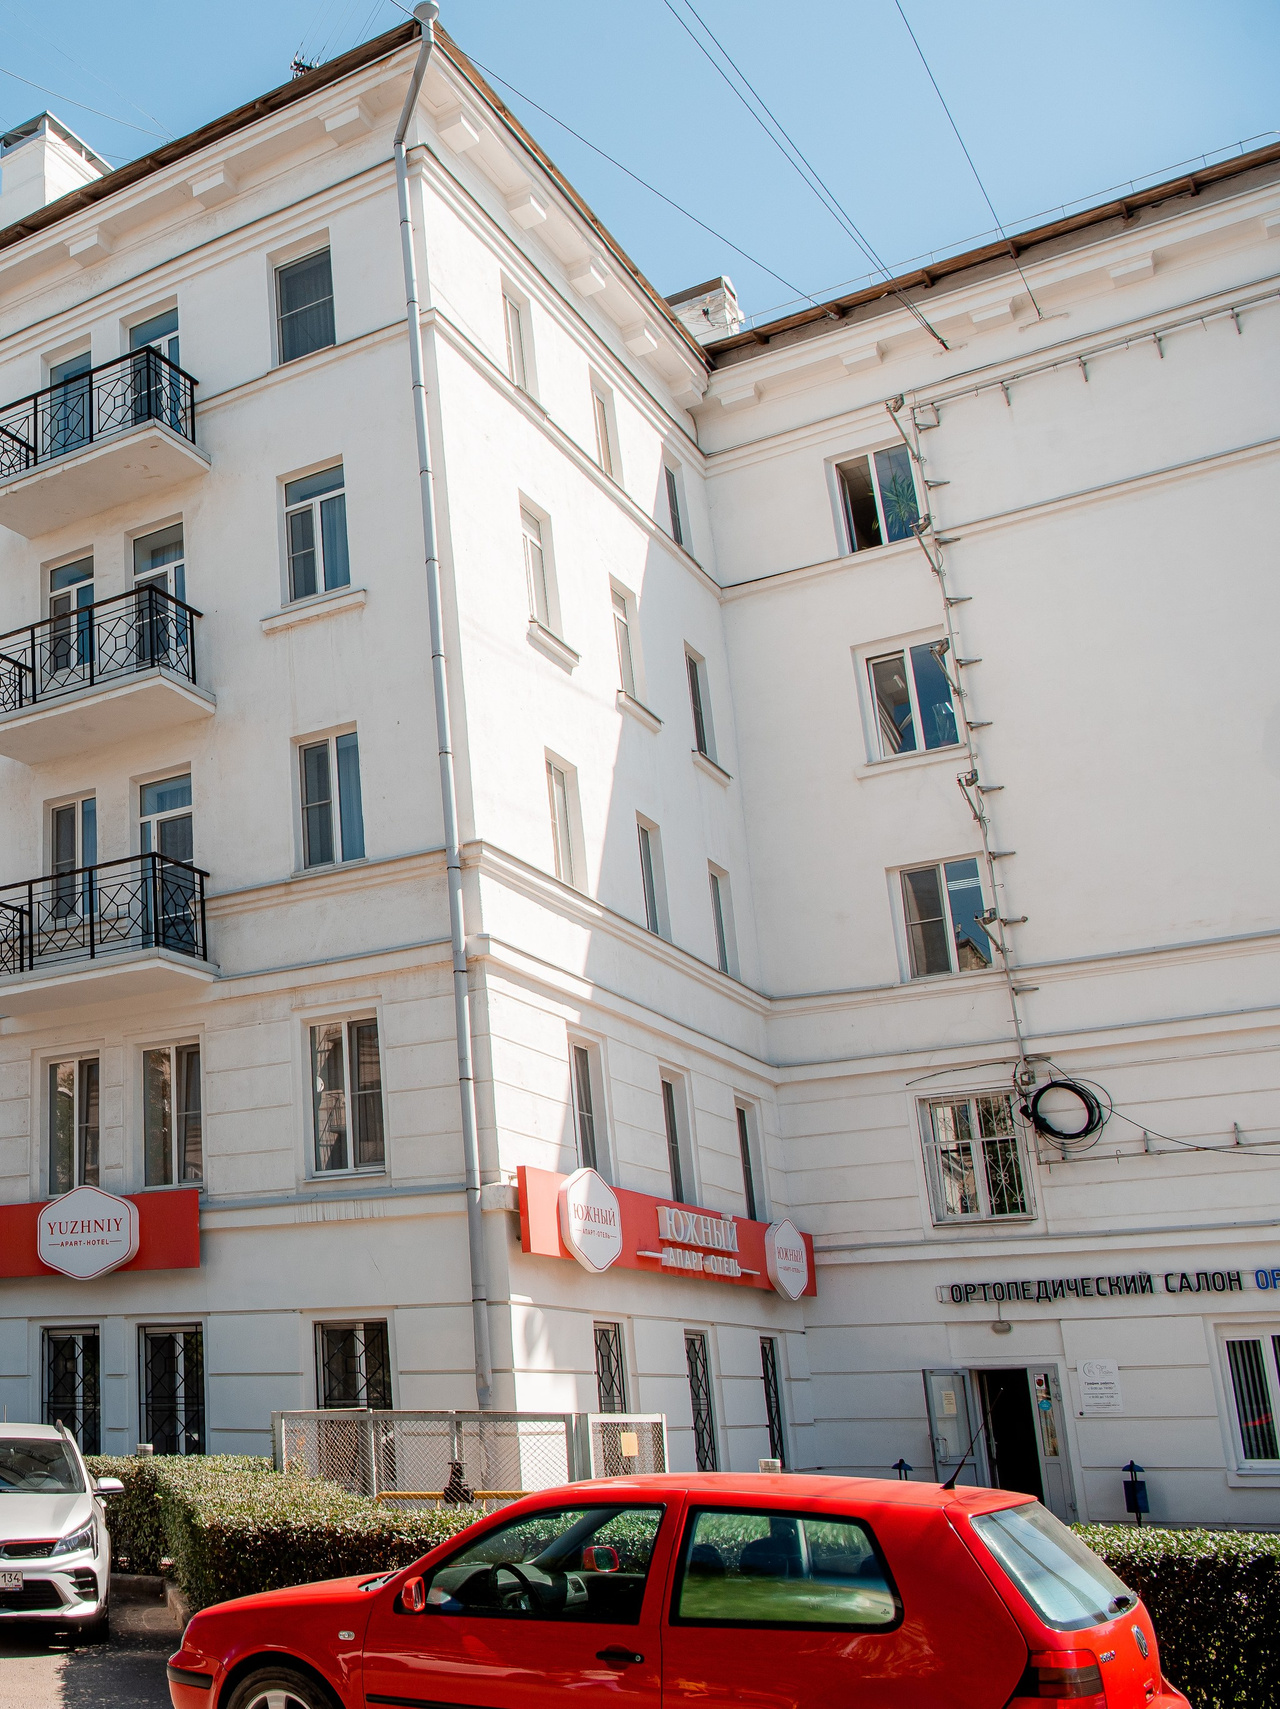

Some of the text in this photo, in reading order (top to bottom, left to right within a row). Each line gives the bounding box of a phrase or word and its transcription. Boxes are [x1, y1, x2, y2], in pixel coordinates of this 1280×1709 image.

[573, 1203, 616, 1227] ЮЖНЫЙ
[47, 1217, 124, 1236] YUZHNIY
[656, 1205, 740, 1253] ЮЖНЫЙ
[59, 1238, 110, 1248] APART-HOTEL
[661, 1246, 742, 1278] АПАРТ-ОТЕЛЬ
[776, 1246, 804, 1264] ЮЖНЫЙ
[950, 1270, 1154, 1303] ОРТОПЕДИЧЕСКИЙ
[1164, 1270, 1243, 1293] САЛОН
[1, 1573, 20, 1583] 134
